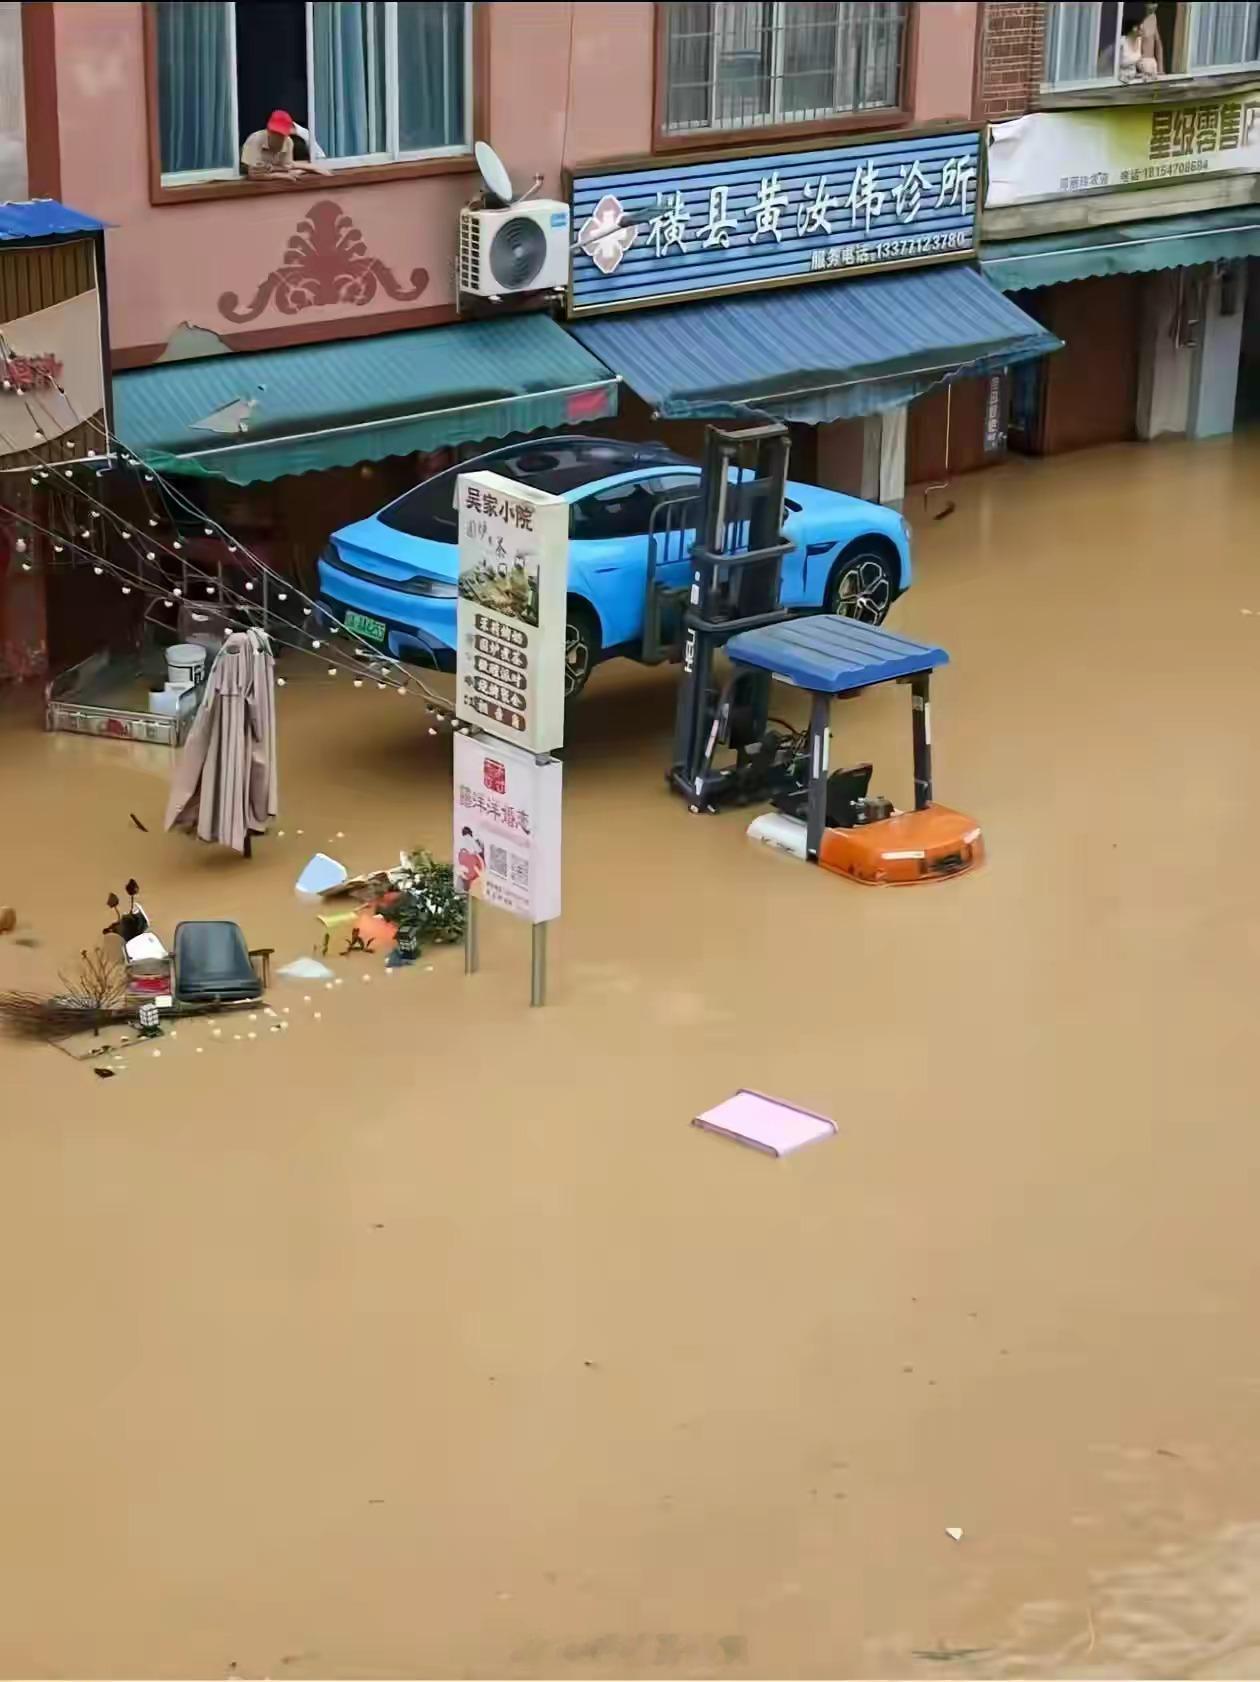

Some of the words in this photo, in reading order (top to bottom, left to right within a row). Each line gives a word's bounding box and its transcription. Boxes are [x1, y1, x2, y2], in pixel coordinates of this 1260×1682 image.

[645, 154, 976, 258] 横县黄汝伟诊所
[466, 486, 534, 532] 吴家小院
